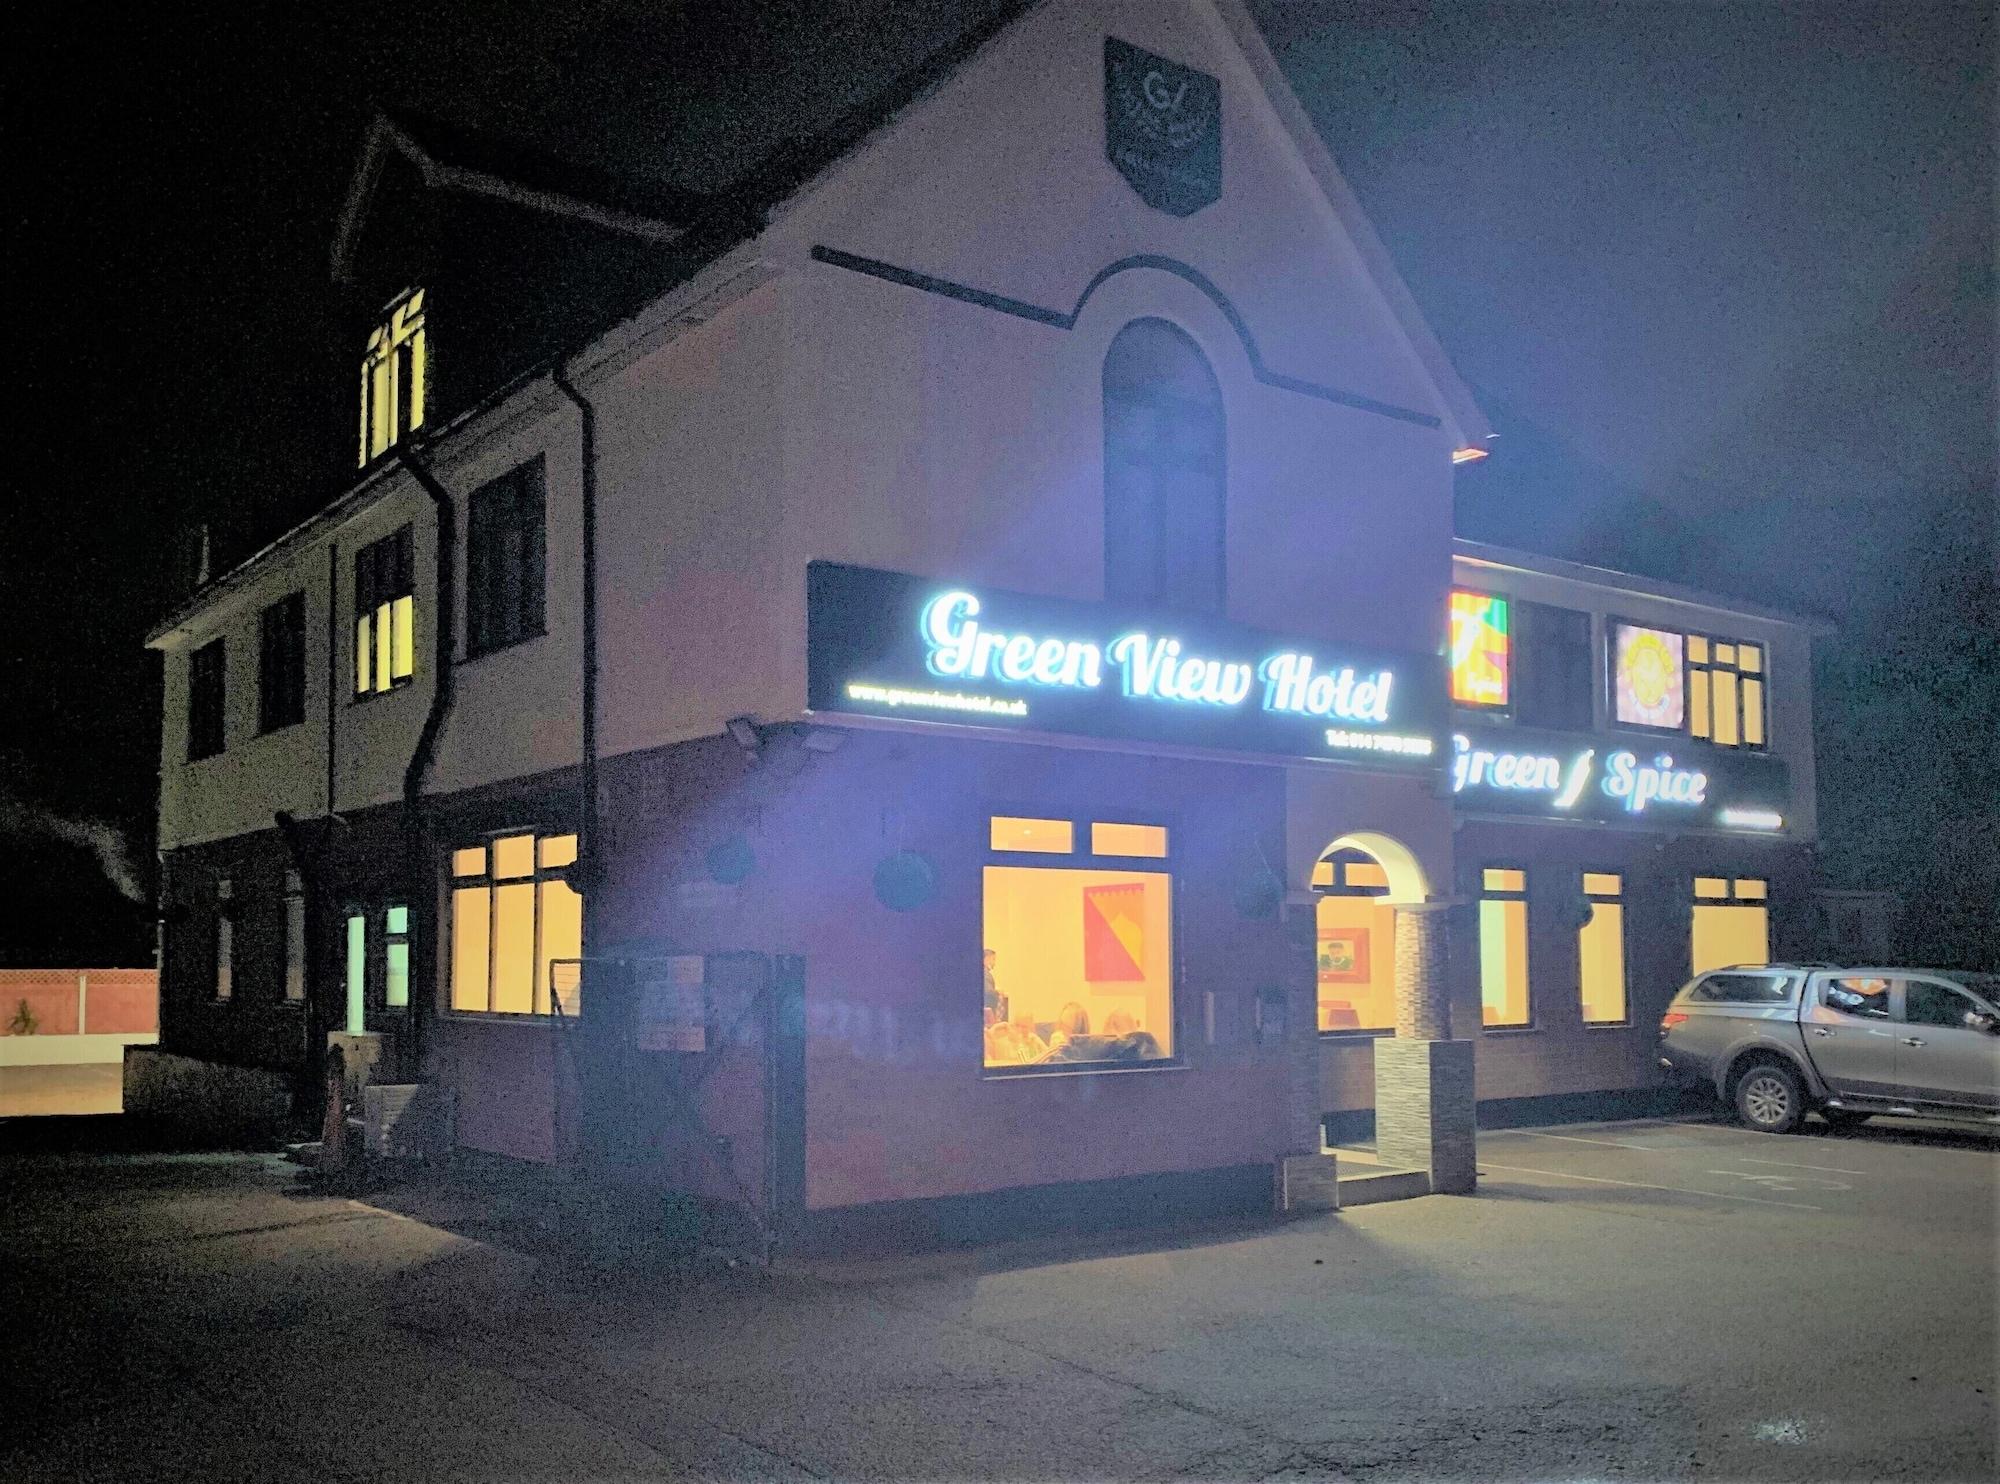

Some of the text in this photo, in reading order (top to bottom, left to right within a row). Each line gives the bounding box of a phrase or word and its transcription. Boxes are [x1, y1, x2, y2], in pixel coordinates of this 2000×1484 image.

[921, 591, 1392, 722] Green View Hotel
[1602, 750, 1708, 812] Spice
